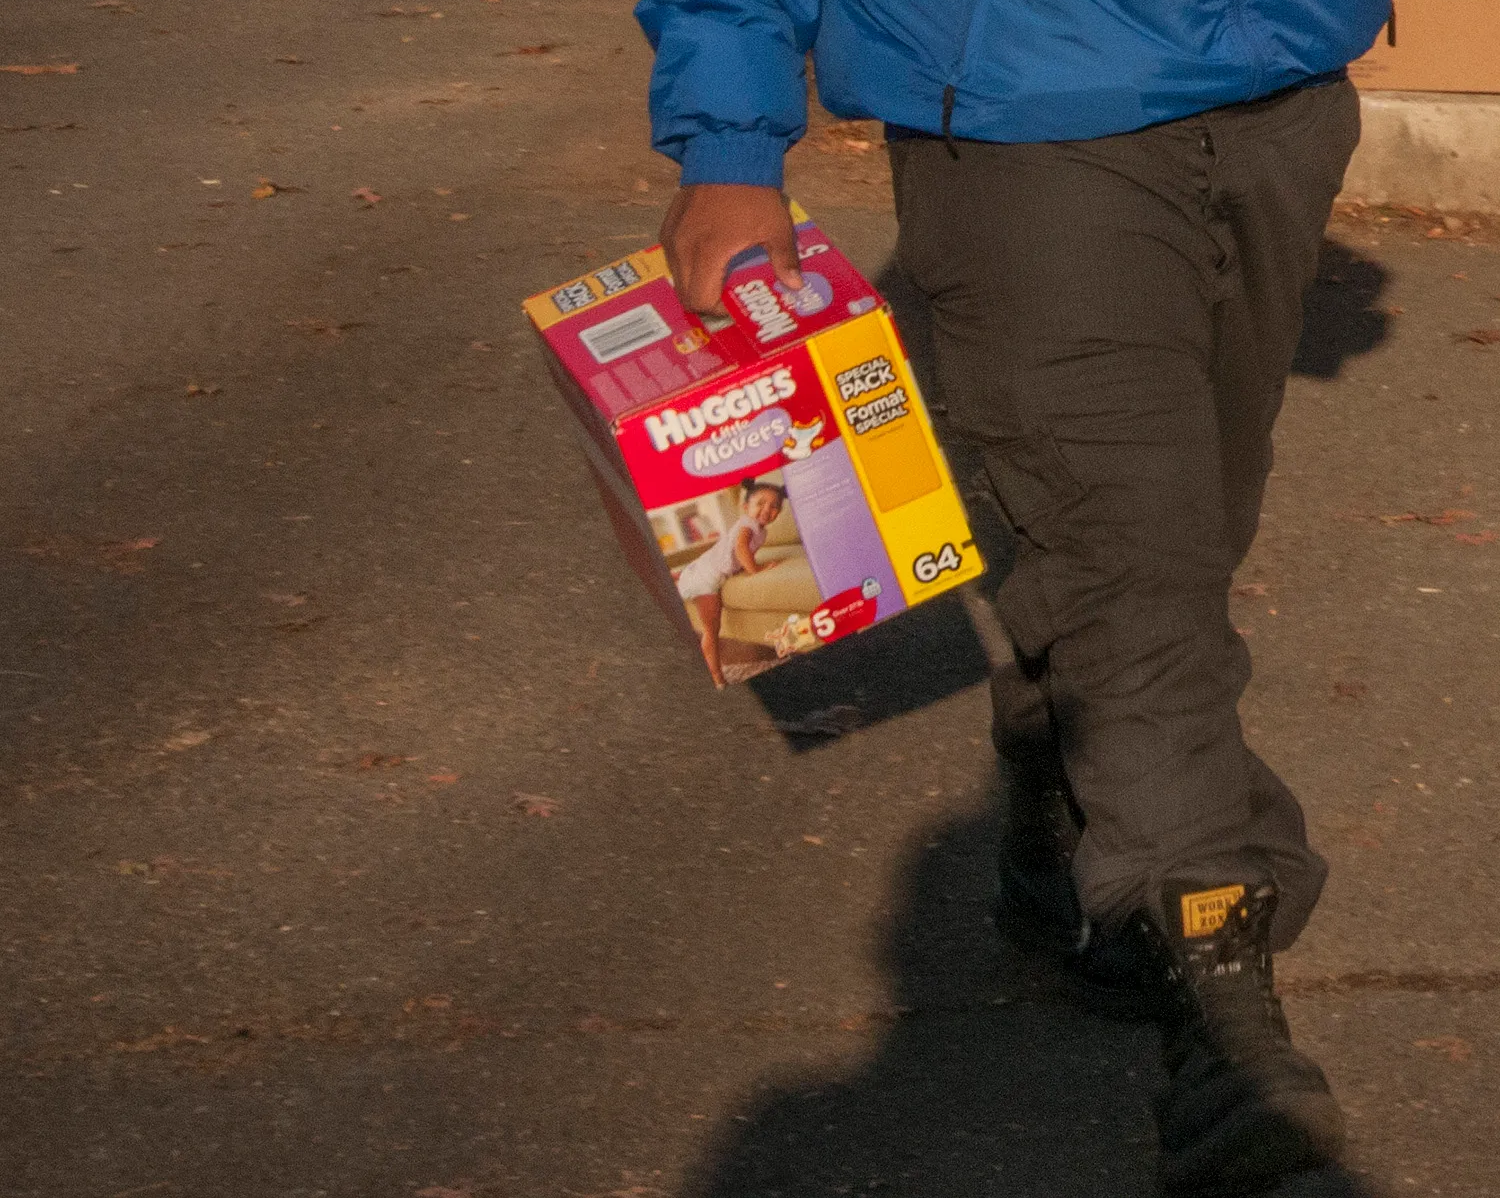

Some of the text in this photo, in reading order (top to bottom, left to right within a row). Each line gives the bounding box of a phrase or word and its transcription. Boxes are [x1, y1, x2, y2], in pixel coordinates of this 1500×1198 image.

[734, 279, 798, 344] HUGGIES
[835, 355, 890, 384] SPECIAL
[840, 366, 896, 401] PACK
[645, 368, 797, 452] HUGGIES
[845, 386, 909, 425] Format
[694, 418, 785, 471] Movers
[913, 542, 963, 583] 64
[813, 608, 836, 638] 5
